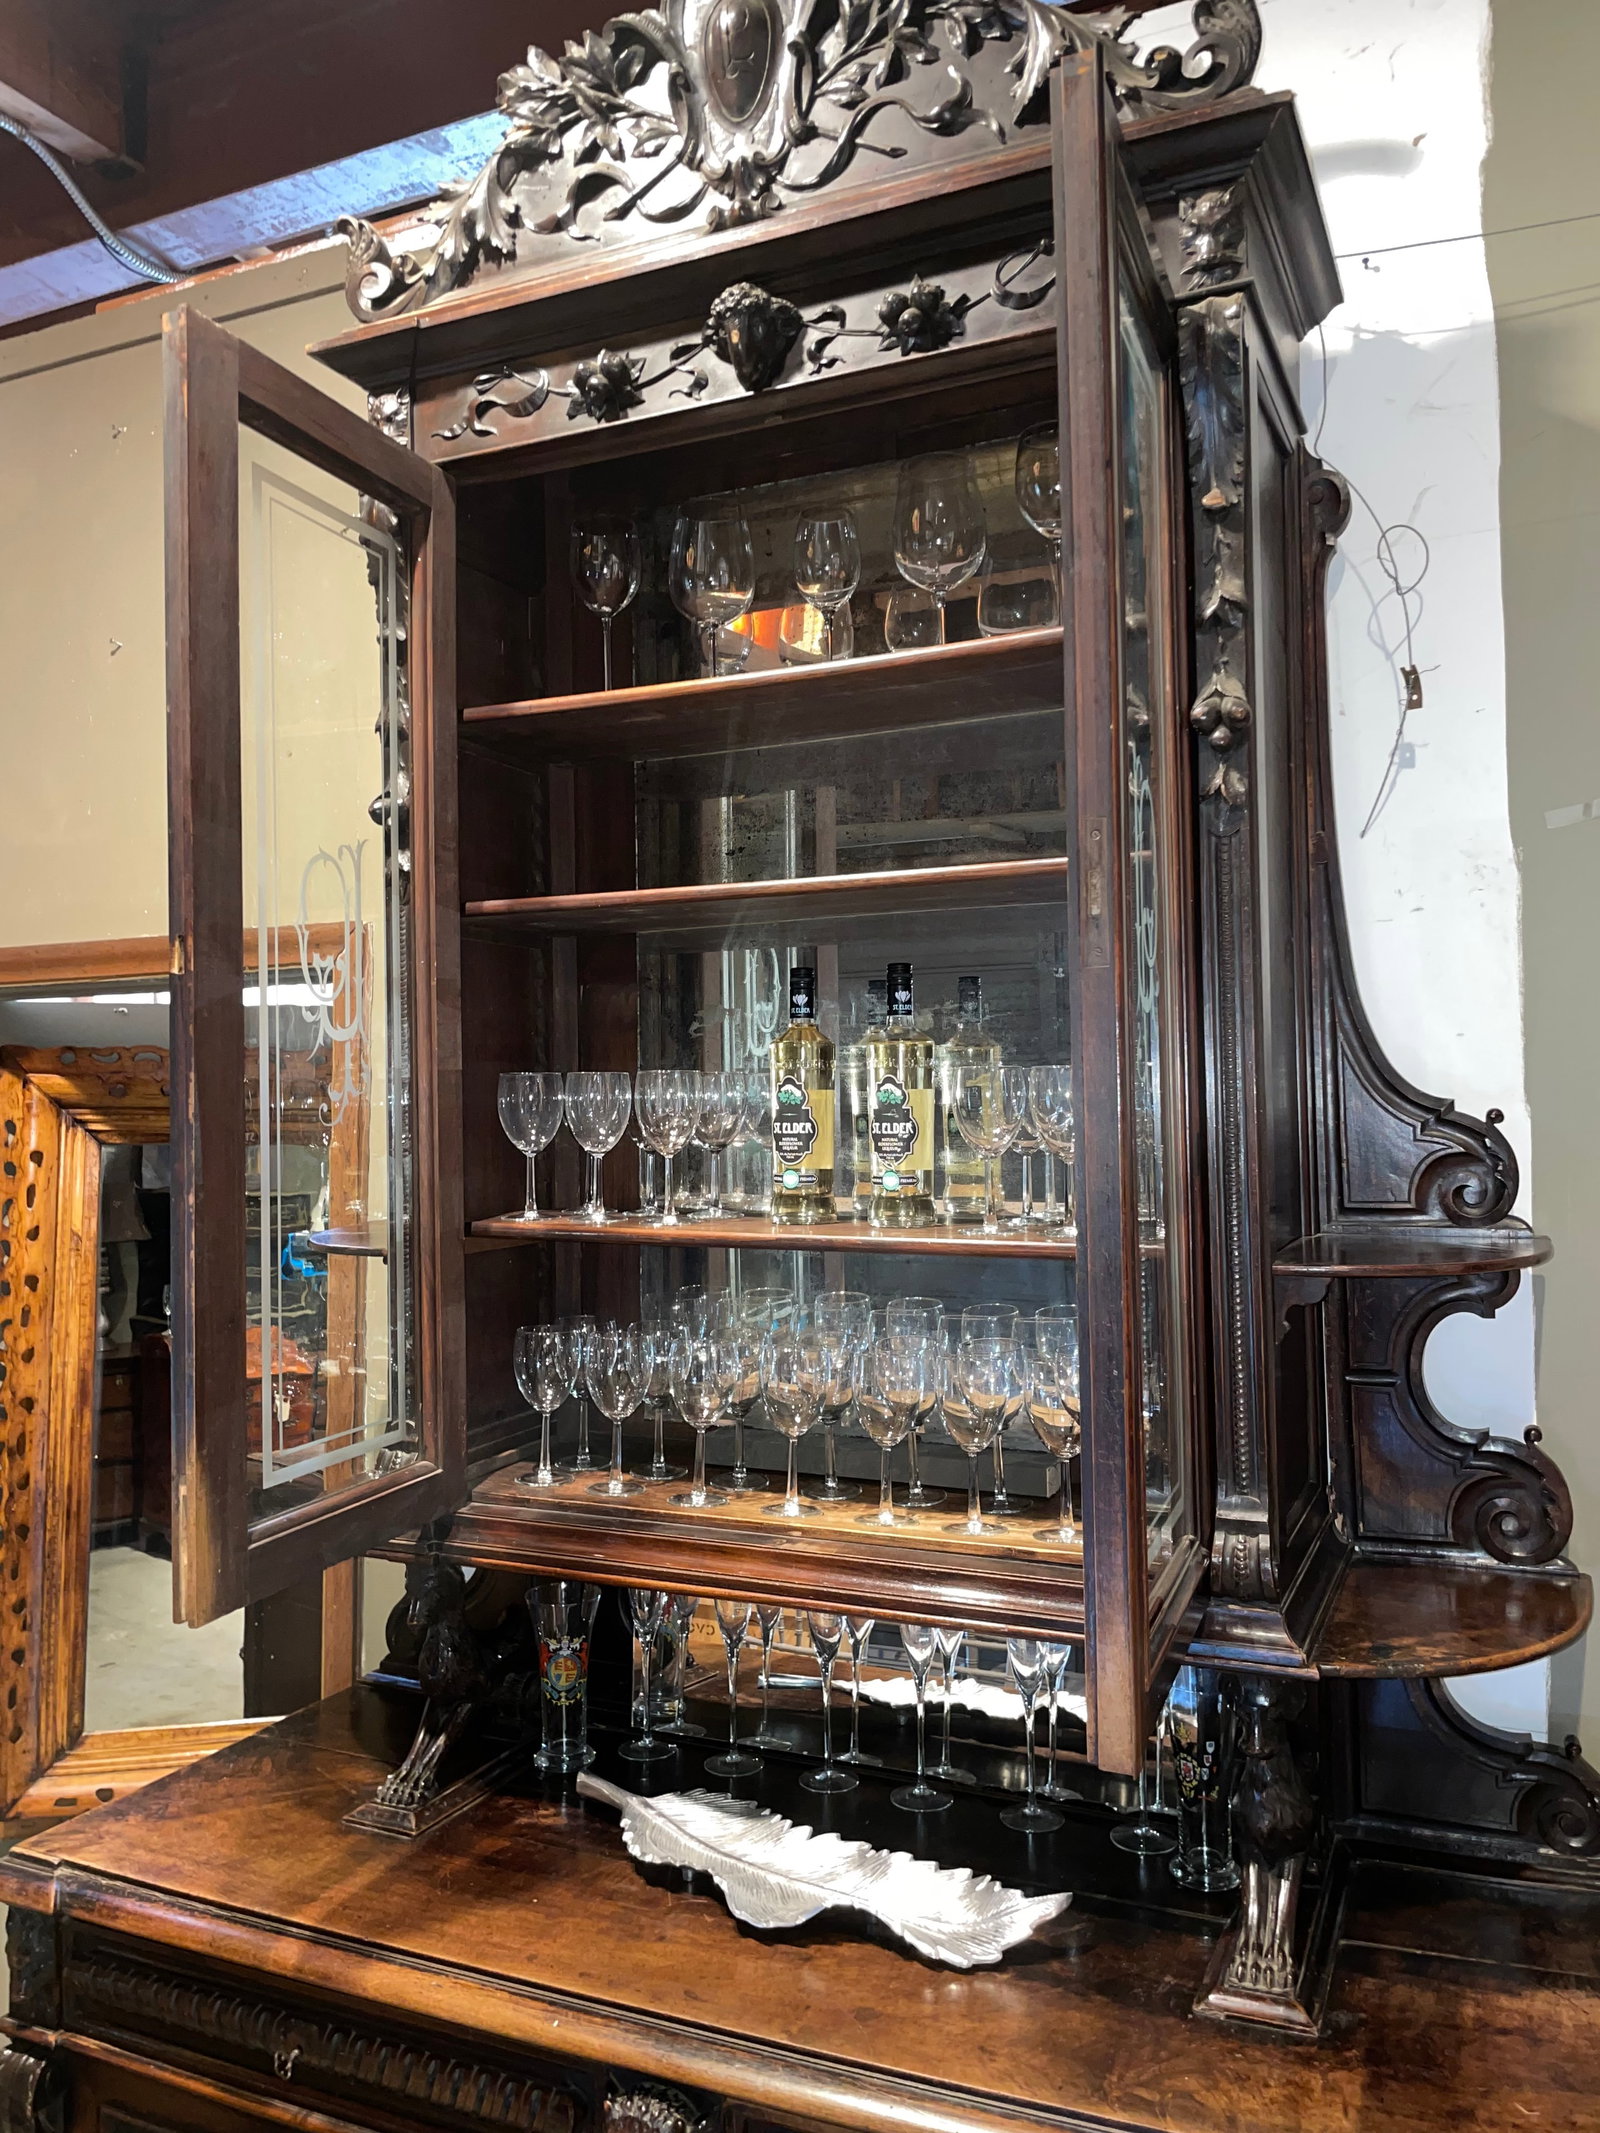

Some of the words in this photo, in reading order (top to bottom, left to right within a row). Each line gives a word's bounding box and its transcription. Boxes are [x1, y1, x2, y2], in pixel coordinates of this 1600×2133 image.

[782, 1122, 814, 1134] ELDER
[872, 1122, 881, 1134] ST.
[882, 1121, 914, 1134] ELDER
